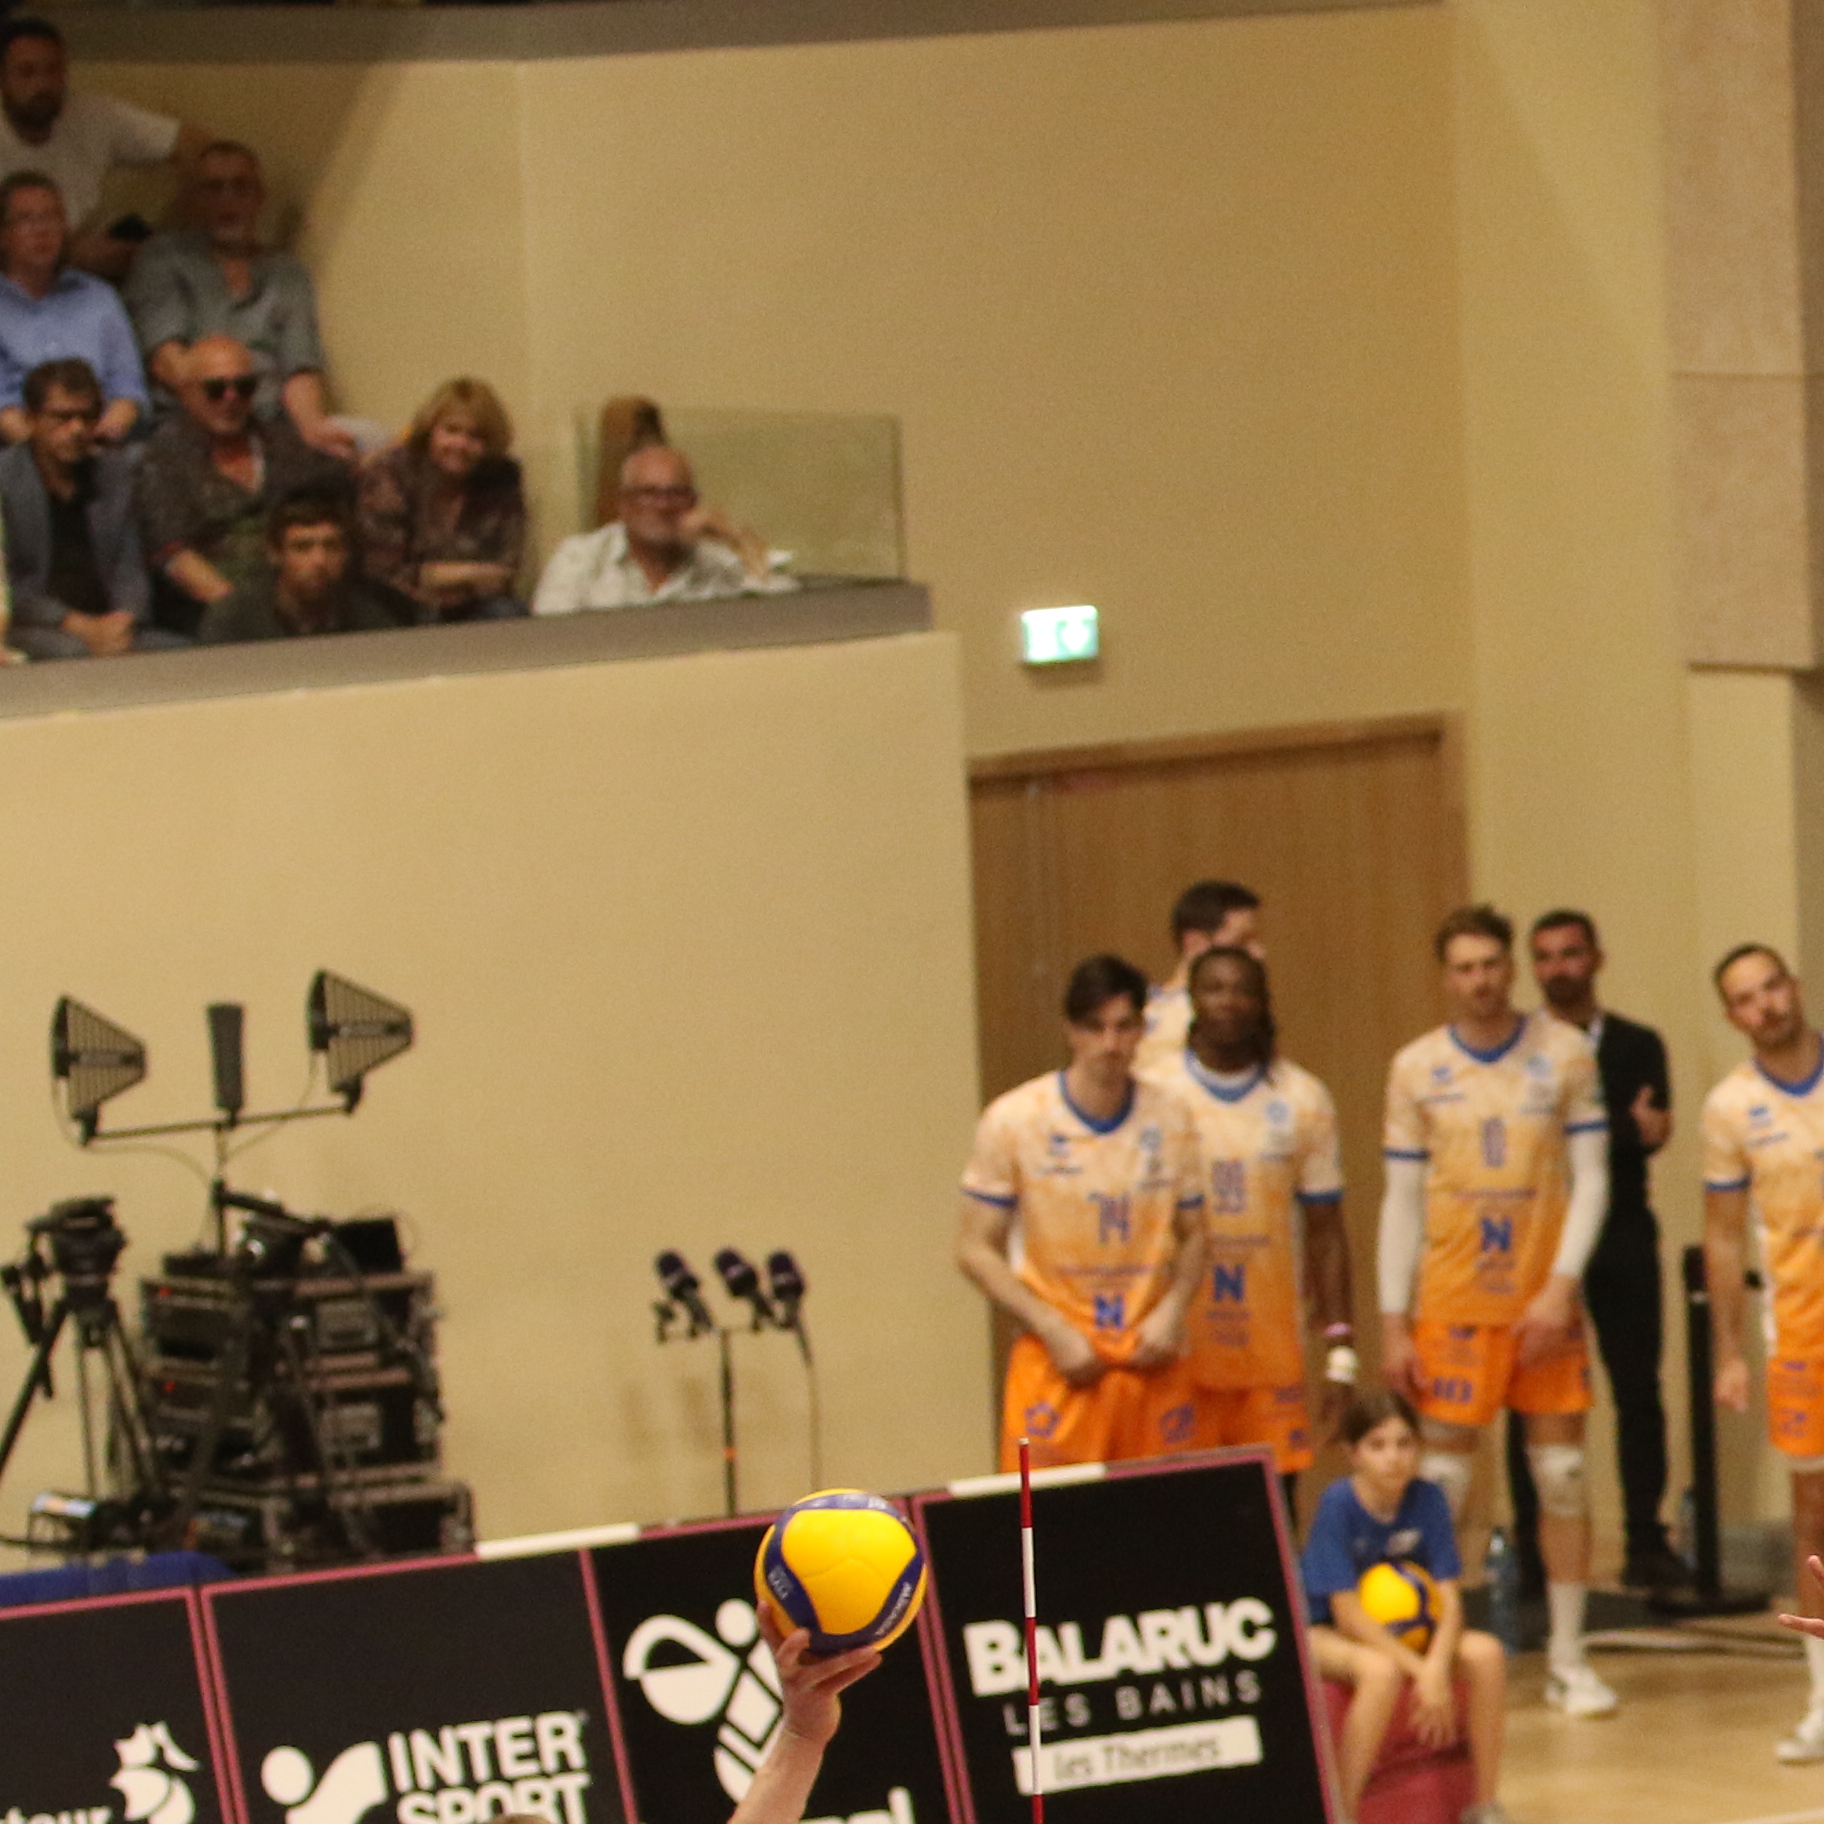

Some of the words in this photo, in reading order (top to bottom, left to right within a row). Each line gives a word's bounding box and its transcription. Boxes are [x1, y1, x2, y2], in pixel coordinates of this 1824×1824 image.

[963, 1596, 1278, 1698] BALARUC
[1003, 1692, 1092, 1736] LES
[1115, 1668, 1262, 1721] BAINS
[387, 1709, 588, 1795] INTER
